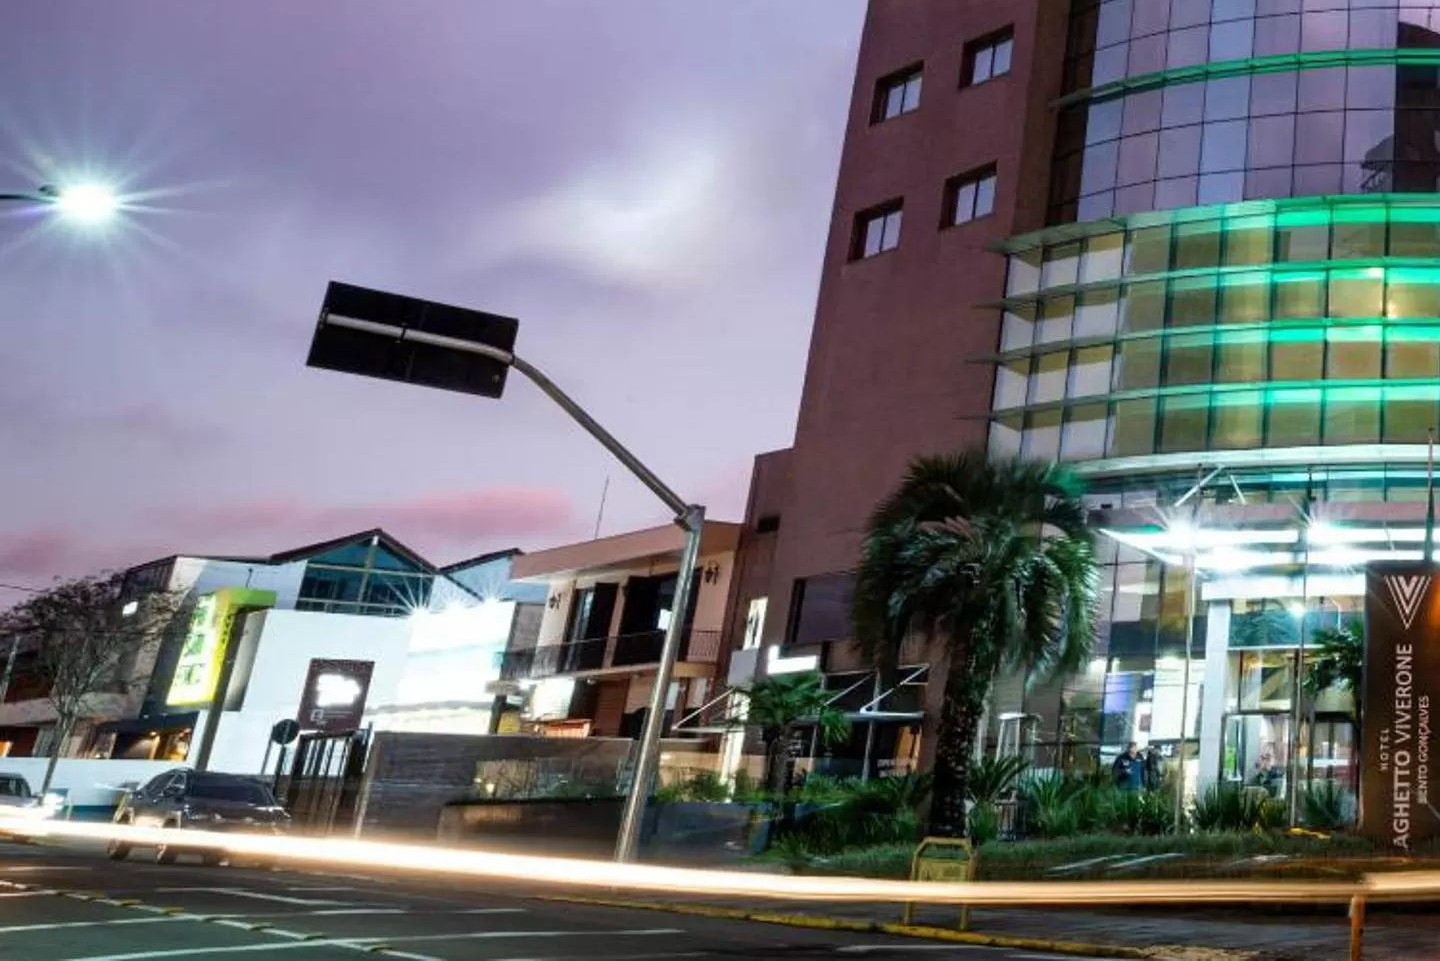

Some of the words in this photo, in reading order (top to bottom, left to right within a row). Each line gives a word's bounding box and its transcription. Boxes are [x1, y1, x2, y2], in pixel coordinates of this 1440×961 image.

[1394, 643, 1412, 744] VIVERONE
[1418, 695, 1431, 763] GONÇALVES
[1380, 728, 1389, 771] HOTEL
[1393, 750, 1411, 851] AGHETTO
